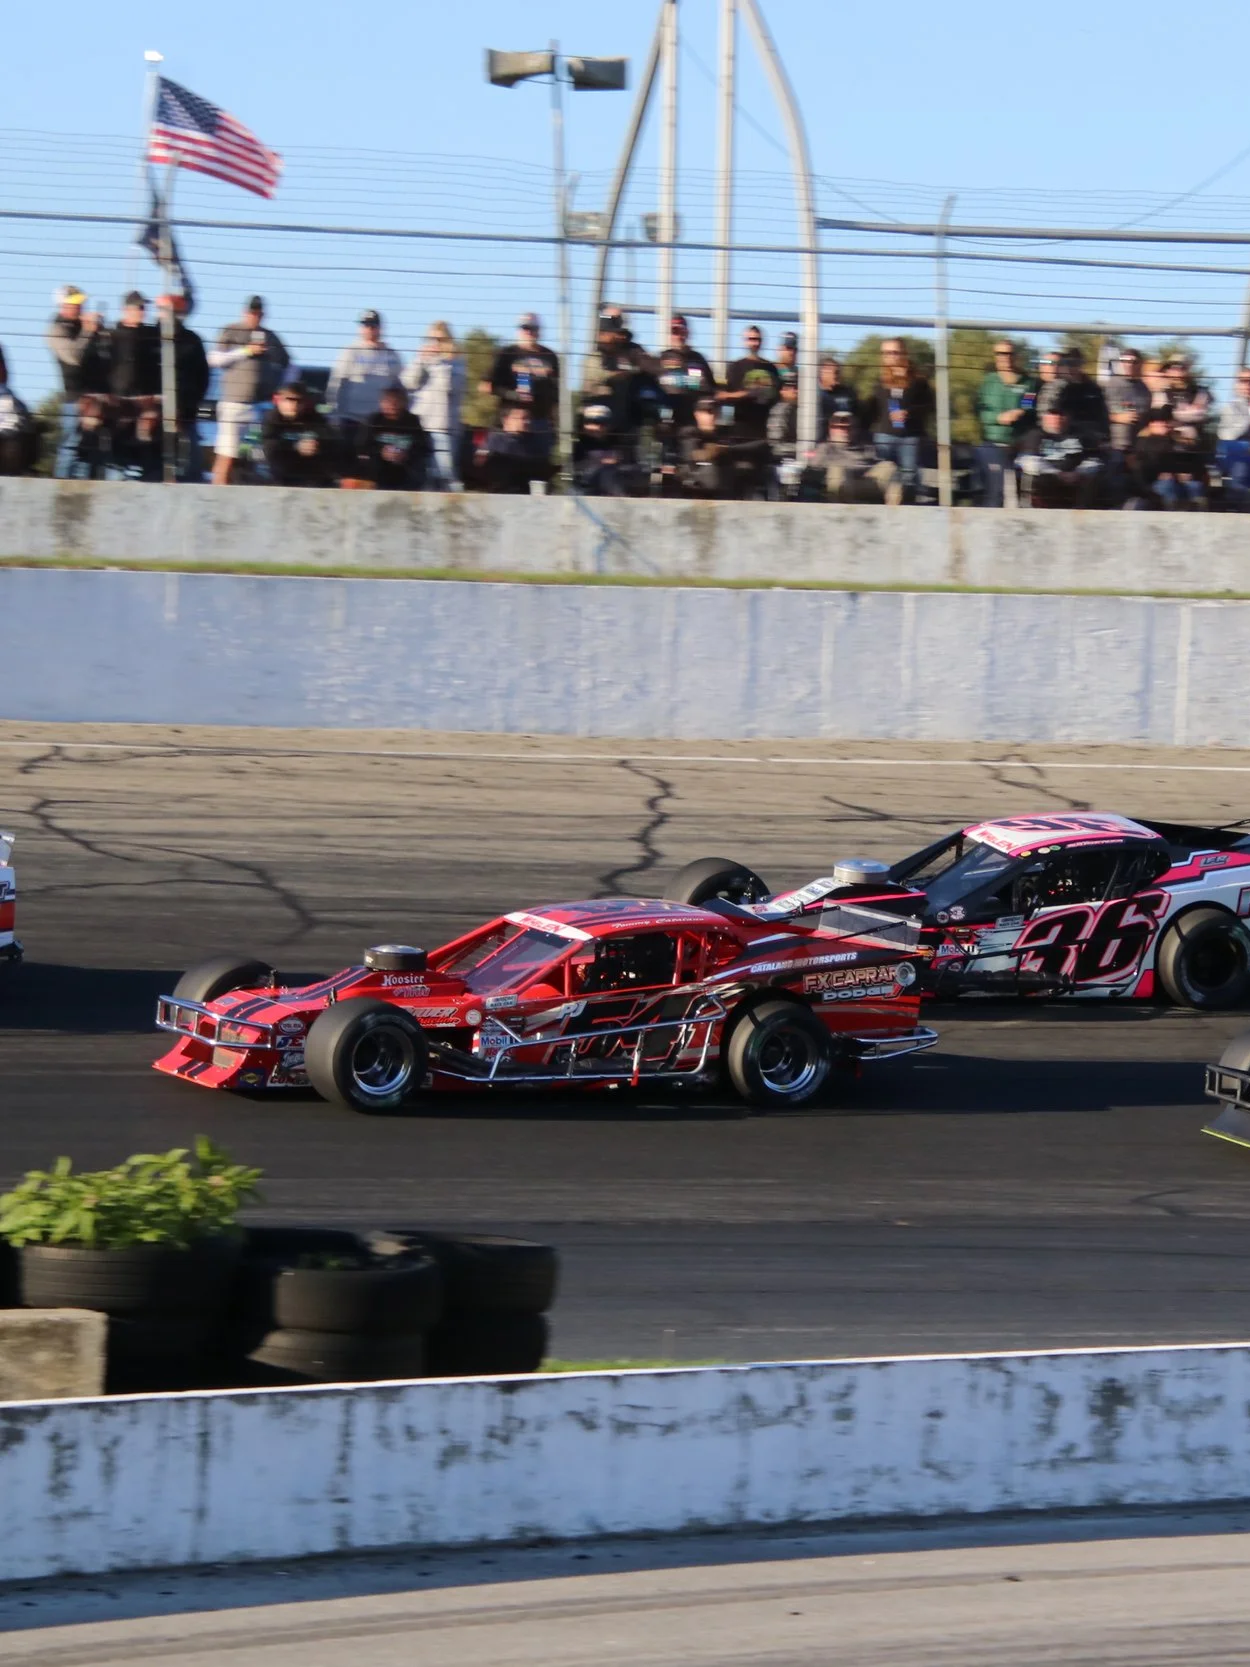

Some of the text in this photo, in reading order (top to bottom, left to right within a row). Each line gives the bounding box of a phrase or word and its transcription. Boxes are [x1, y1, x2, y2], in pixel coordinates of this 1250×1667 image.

[1012, 889, 1171, 983] 36
[751, 952, 858, 974] CATALANO MOTORSPORTS
[382, 973, 425, 986] Hoosier
[804, 965, 901, 993] FX CAPRAR
[822, 985, 895, 1001] DODGE
[481, 1035, 508, 1047] Mobil
